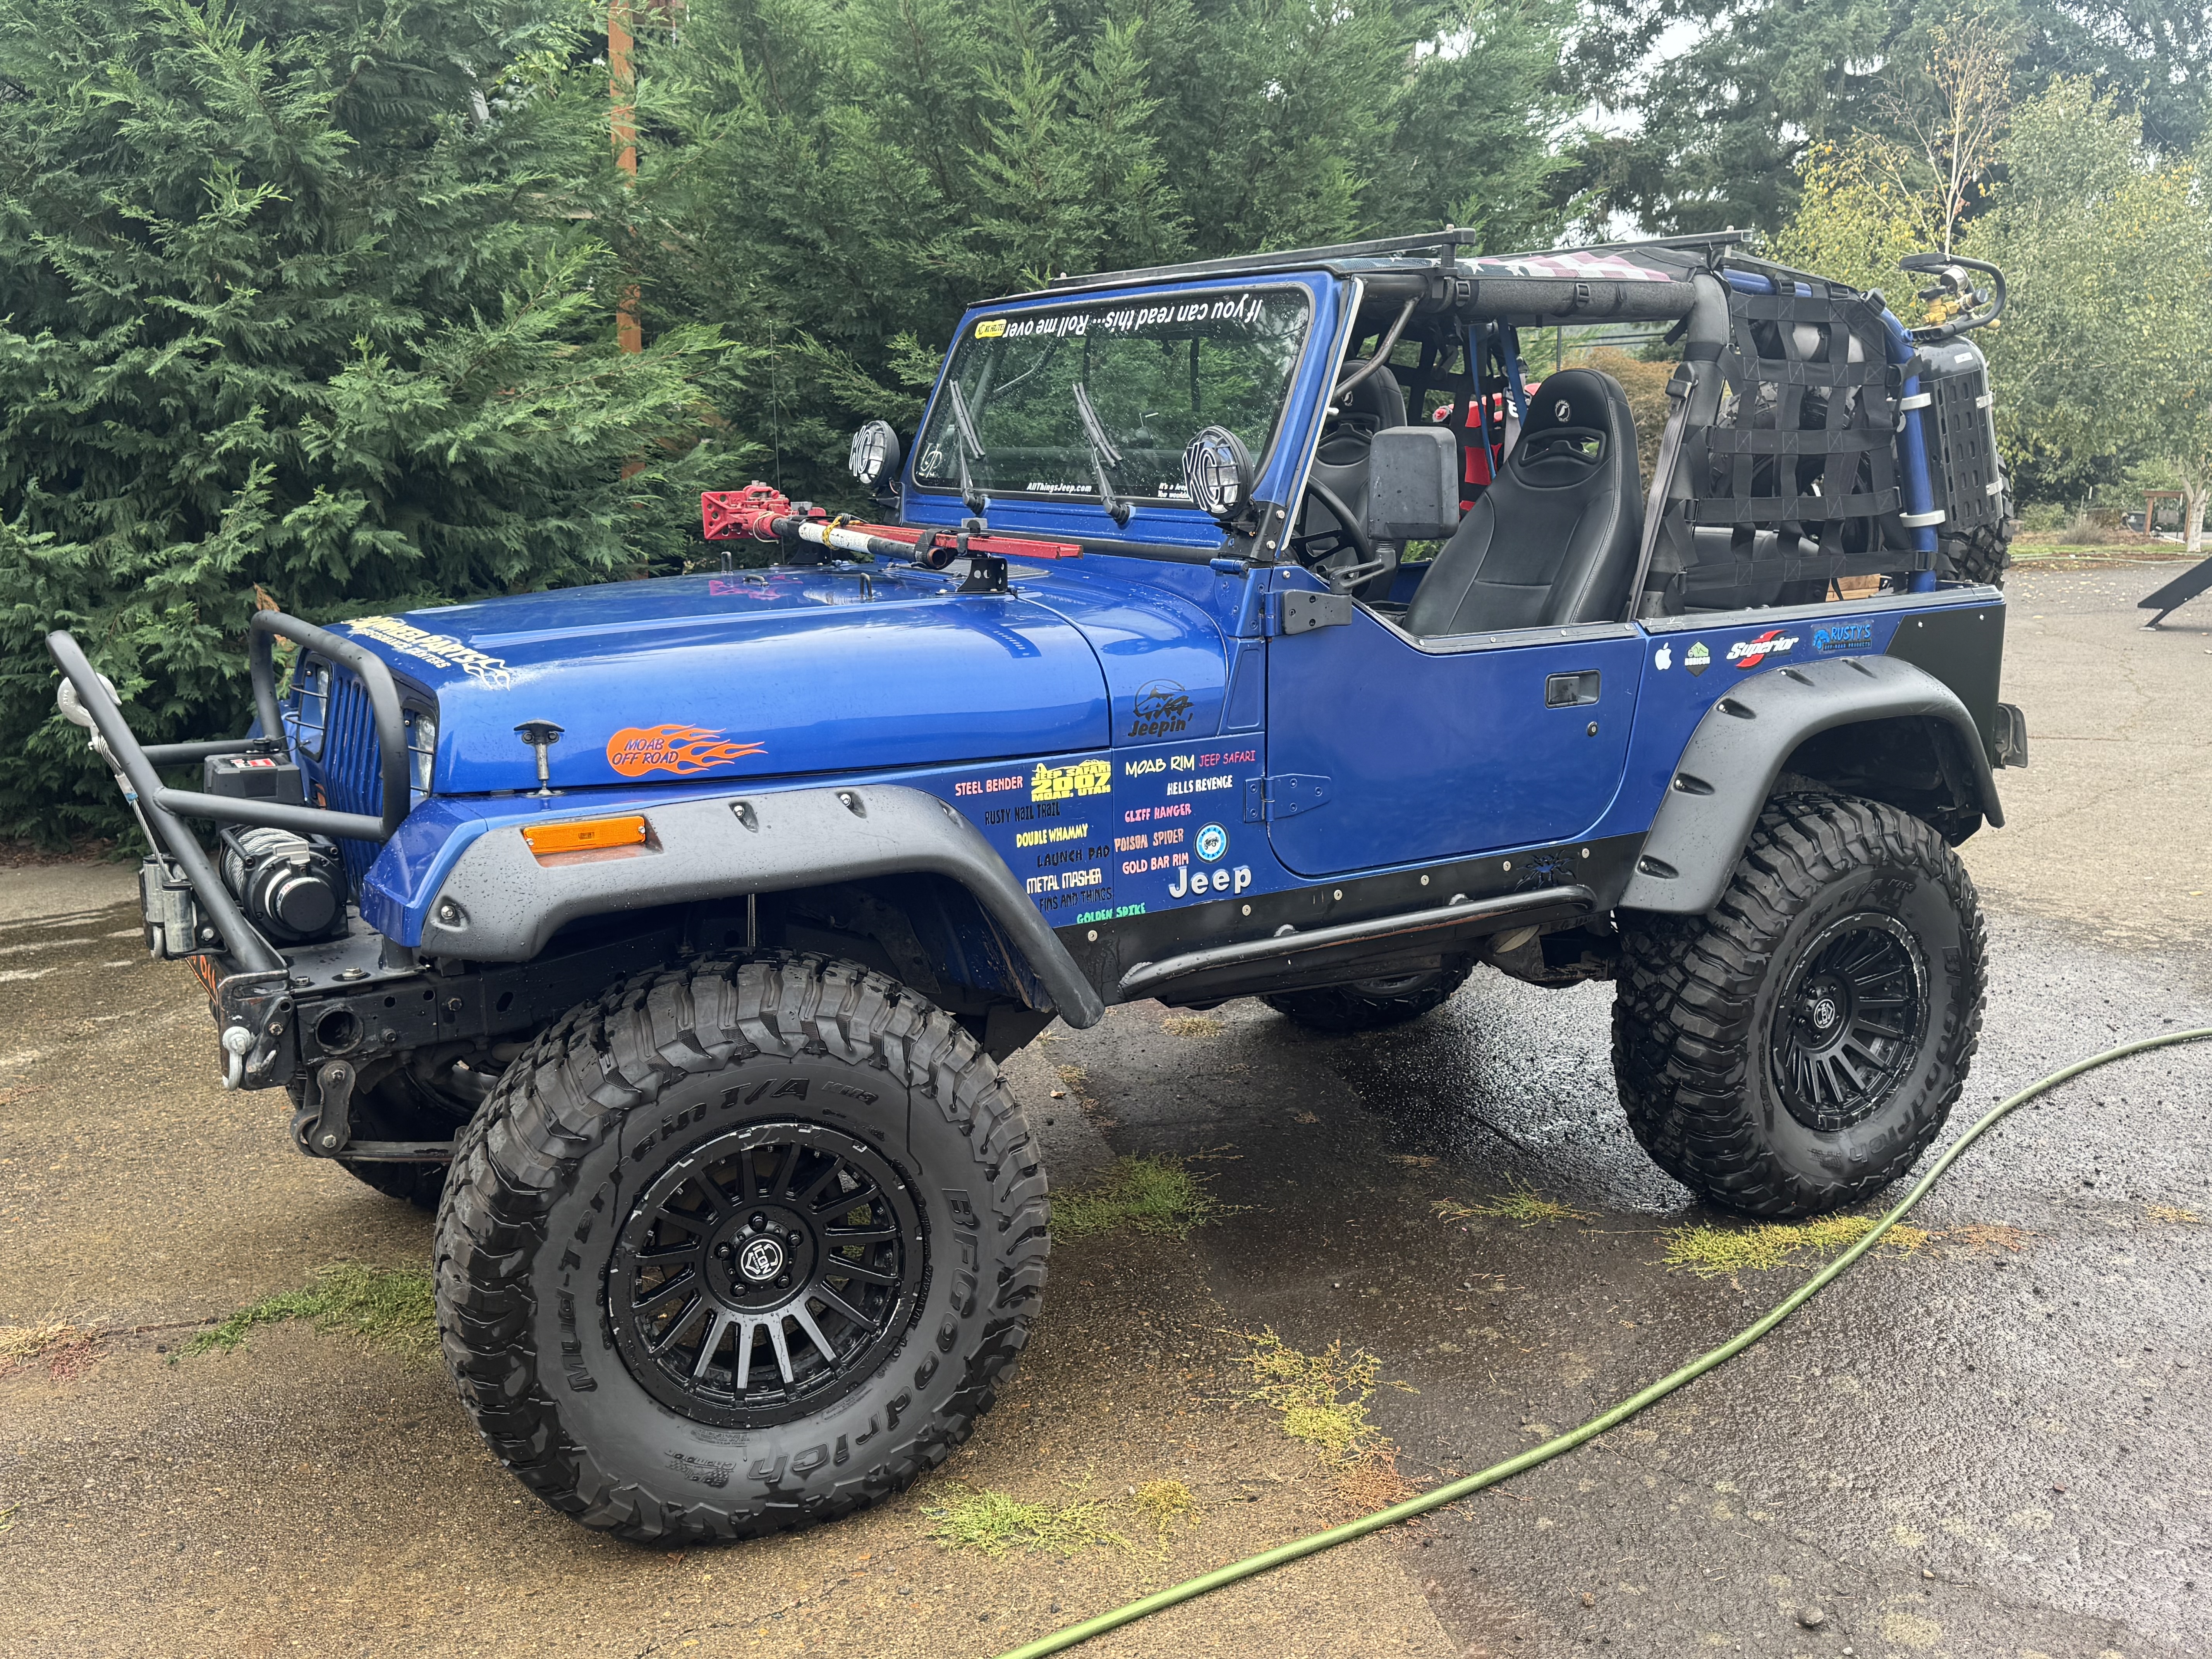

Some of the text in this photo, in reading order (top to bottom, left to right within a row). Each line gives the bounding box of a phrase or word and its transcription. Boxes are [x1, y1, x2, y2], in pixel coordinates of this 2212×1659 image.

[1177, 303, 1209, 322] can
[1211, 294, 1249, 319] you
[1244, 299, 1263, 323] If
[1002, 320, 1034, 338] over
[1036, 318, 1058, 335] me
[1057, 314, 1089, 335] Roll
[1135, 306, 1175, 331] read
[849, 425, 872, 477] KC
[1182, 441, 1220, 511] KC
[1027, 482, 1092, 493] AllThingsJeep.com
[1831, 624, 1871, 641] RUSTY'S
[1726, 637, 1800, 660] Superior
[1127, 713, 1194, 738] Jeepin'
[624, 738, 665, 751] MOAB
[612, 750, 679, 765] OFF ROAD
[1125, 754, 1195, 778] MOAB RIM
[1199, 750, 1256, 767] JEEP SAFARI
[1031, 763, 1111, 781] JEEP SAFARI
[1031, 772, 1111, 794] 2007
[955, 776, 1023, 796] STEEL BENDER
[1031, 785, 1111, 802] MOAB, UTAH
[1167, 775, 1233, 796] HELLS REVENGE
[985, 807, 1011, 825] RUSTY
[1124, 803, 1192, 823] CLIFF HANGER
[1016, 823, 1089, 848] DOUBLE WHAMMY
[1114, 828, 1184, 852] POISON SPIDER
[1037, 845, 1110, 868] LAUNCH PAD
[1122, 852, 1189, 874] GOLD BAR RIM
[1027, 868, 1102, 894] METAL MASHER
[1168, 865, 1252, 898] Jeep
[1039, 887, 1113, 911] FINS AND THINGS
[1077, 902, 1146, 924] GOLDEN SPIKE
[721, 1078, 810, 1109] T/A
[752, 1244, 772, 1275] ICON
[747, 1188, 980, 1483] BFGoodrich
